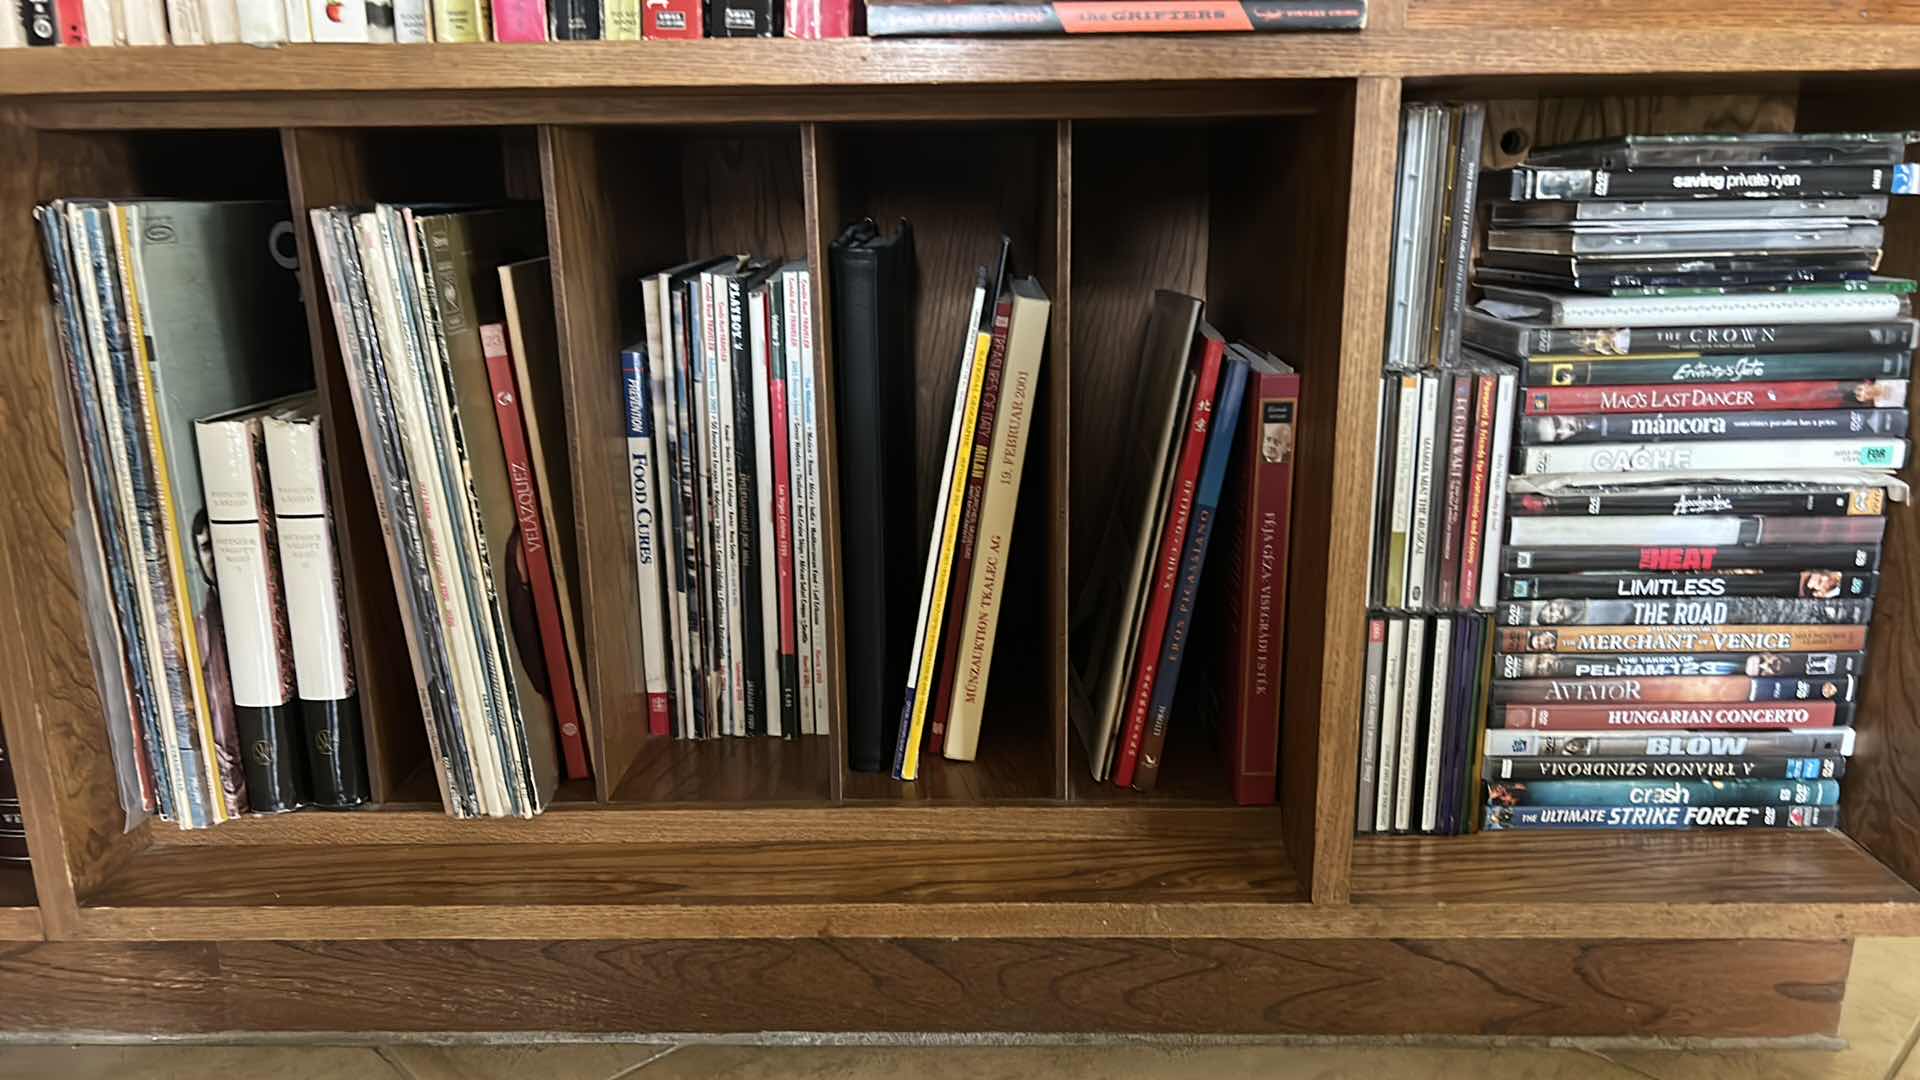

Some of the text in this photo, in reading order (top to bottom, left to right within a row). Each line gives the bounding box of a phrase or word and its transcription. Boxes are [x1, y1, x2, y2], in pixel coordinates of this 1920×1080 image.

[1112, 9, 1226, 21] GRIFTERS
[1672, 172, 1801, 190] saving private ryan
[729, 281, 741, 338] PLAYBOY
[1690, 327, 1776, 343] CROWN
[627, 377, 643, 433] PREVENTION
[1600, 389, 1755, 408] MAO'S LAST DANCER
[1005, 396, 1025, 464] FEBRUAR
[1017, 370, 1029, 394] 2001
[1456, 398, 1467, 425] ROD
[1631, 413, 1726, 434] máncora
[971, 444, 988, 479] MILAN
[1419, 438, 1432, 473] MAMMA
[1451, 426, 1466, 477] STEWART
[631, 453, 653, 565] FOOD CURES
[1417, 498, 1427, 515] THE
[1415, 518, 1427, 555] MUSICAL
[1471, 519, 1480, 535] and
[1617, 578, 1726, 596] LIMITLESS
[965, 535, 1001, 704] MÜNZAUKTION TKALEC AG
[1633, 602, 1728, 625] THE ROAD
[1576, 632, 1698, 650] MERCHANT
[1711, 632, 1792, 650] VENICE
[1575, 664, 1664, 677] PELHAM
[1544, 680, 1641, 700] AVIATOR
[1607, 709, 1809, 725] HUNGARIAN CONCERTO
[1645, 736, 1749, 757] BLOW
[1652, 762, 1735, 776] TRIANON
[1744, 762, 1756, 775] A
[1629, 782, 1690, 804] crash
[1521, 813, 1538, 823] THE
[1540, 809, 1606, 823] ULTIMATE
[1607, 808, 1679, 825] STRIKE
